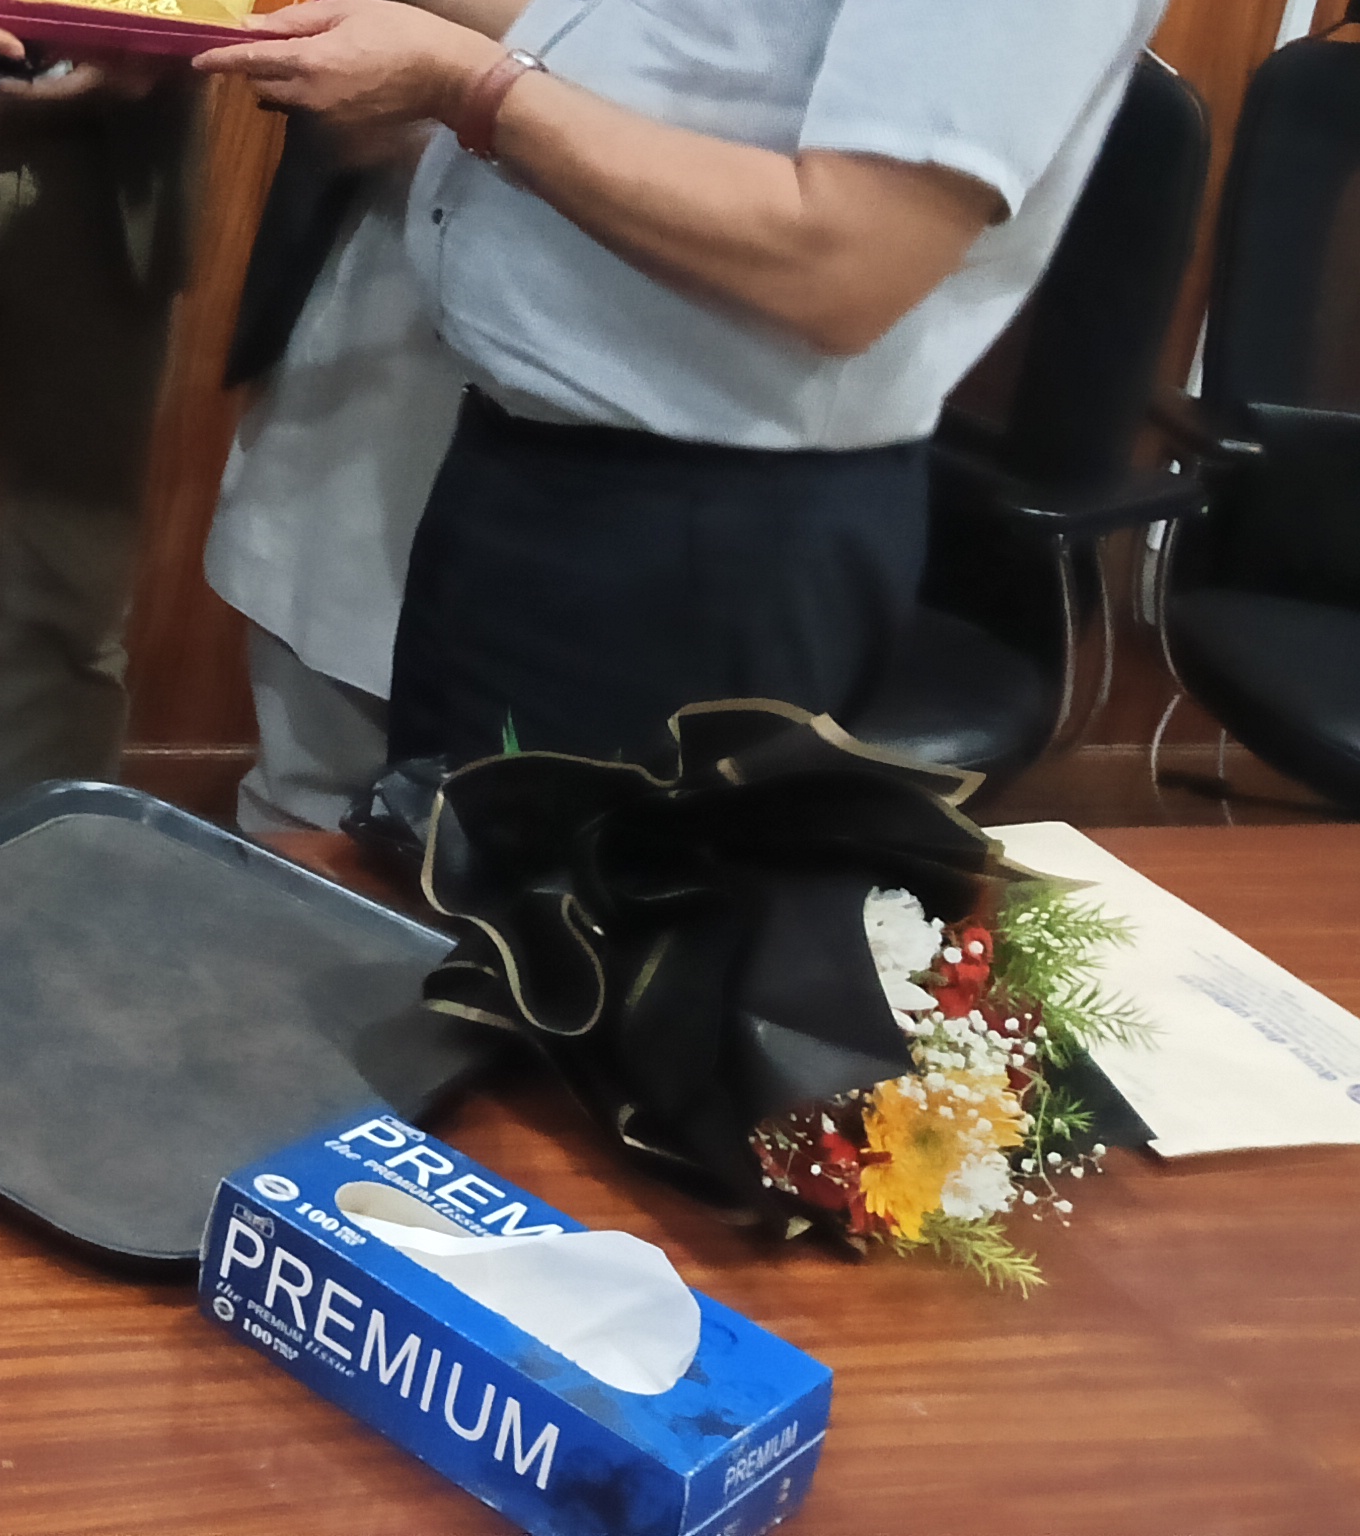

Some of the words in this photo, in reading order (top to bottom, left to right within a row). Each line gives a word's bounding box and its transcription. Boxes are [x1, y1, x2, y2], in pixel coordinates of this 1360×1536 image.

[339, 1118, 565, 1237] PREM
[363, 1158, 435, 1203] PREMIUM
[294, 1201, 340, 1236] 100
[215, 1280, 243, 1304] the
[247, 1299, 304, 1343] PREMIUM
[305, 1337, 357, 1378] tissue
[219, 1217, 561, 1491] PREMIUM
[242, 1318, 274, 1346] 100
[723, 1419, 799, 1496] PREMIUM
